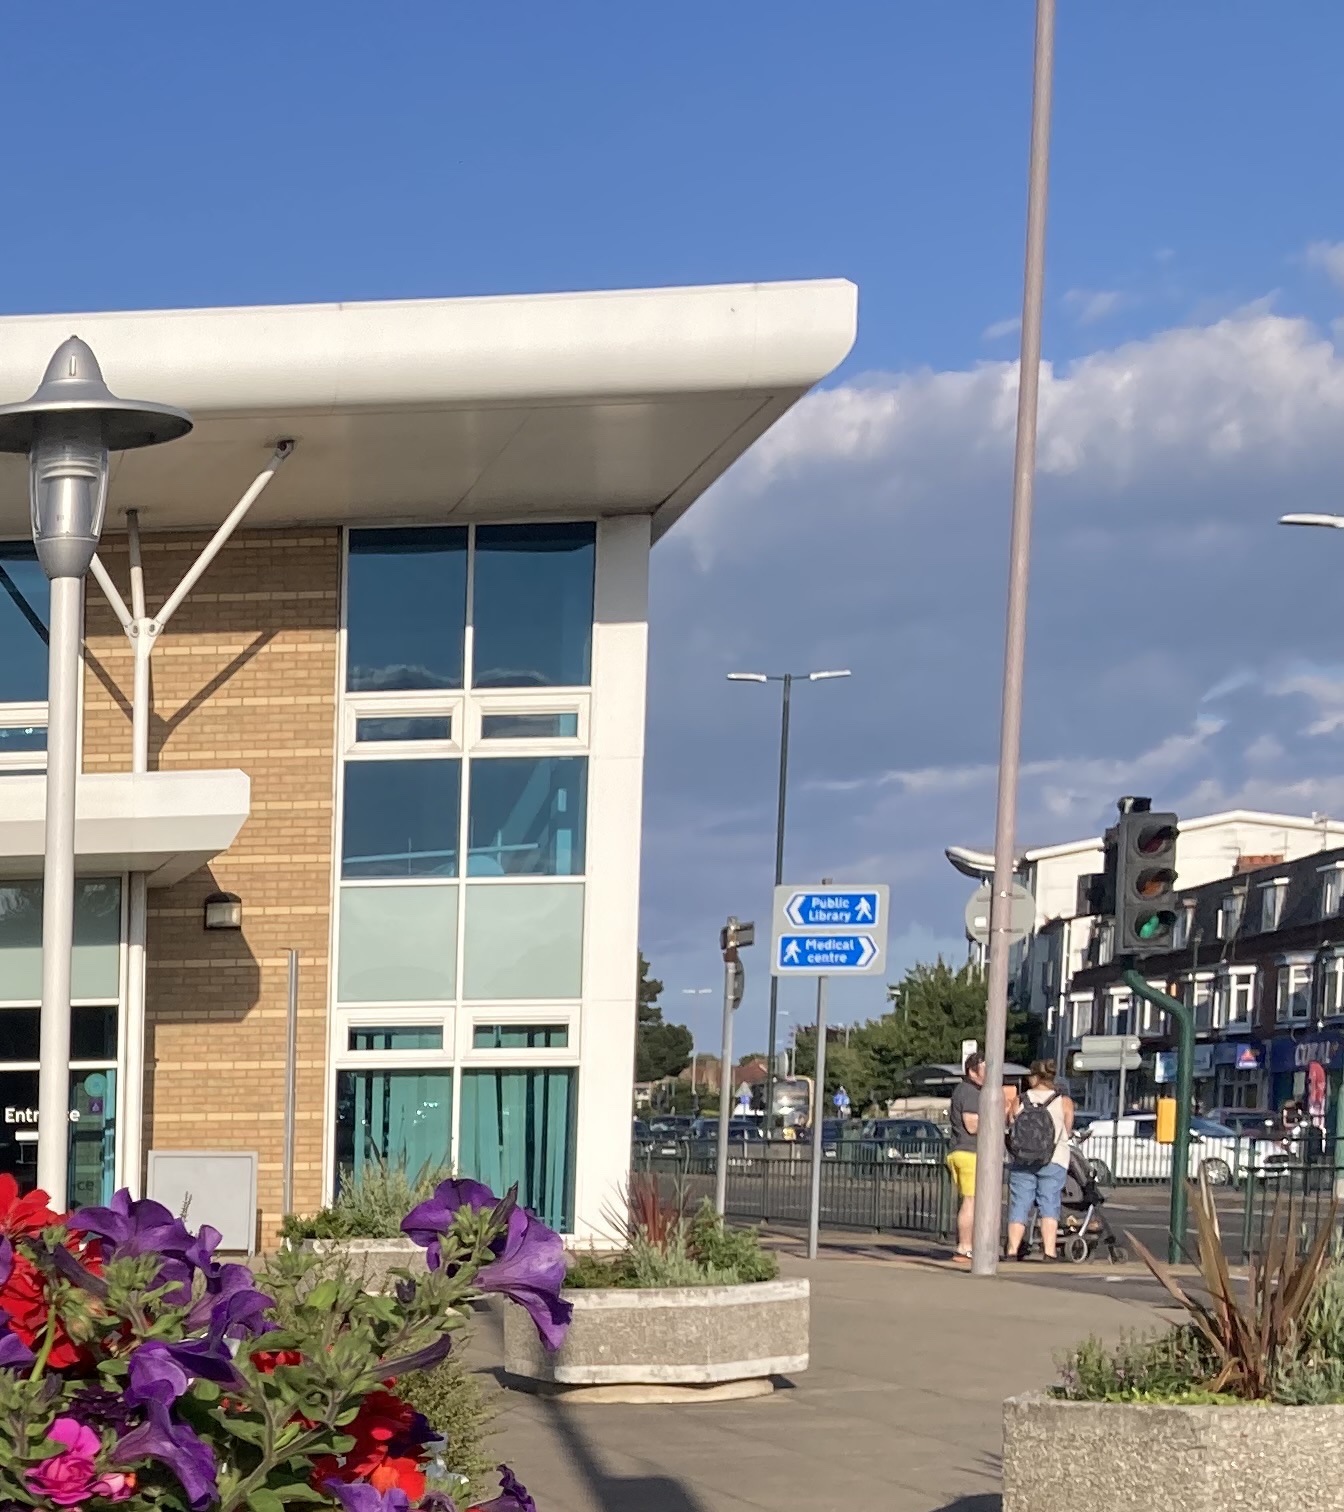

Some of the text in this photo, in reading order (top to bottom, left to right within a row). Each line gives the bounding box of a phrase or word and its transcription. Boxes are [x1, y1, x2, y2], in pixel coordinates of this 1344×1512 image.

[812, 897, 850, 909] Public
[809, 910, 852, 923] Library
[806, 939, 855, 951] Medical
[807, 952, 848, 963] centre
